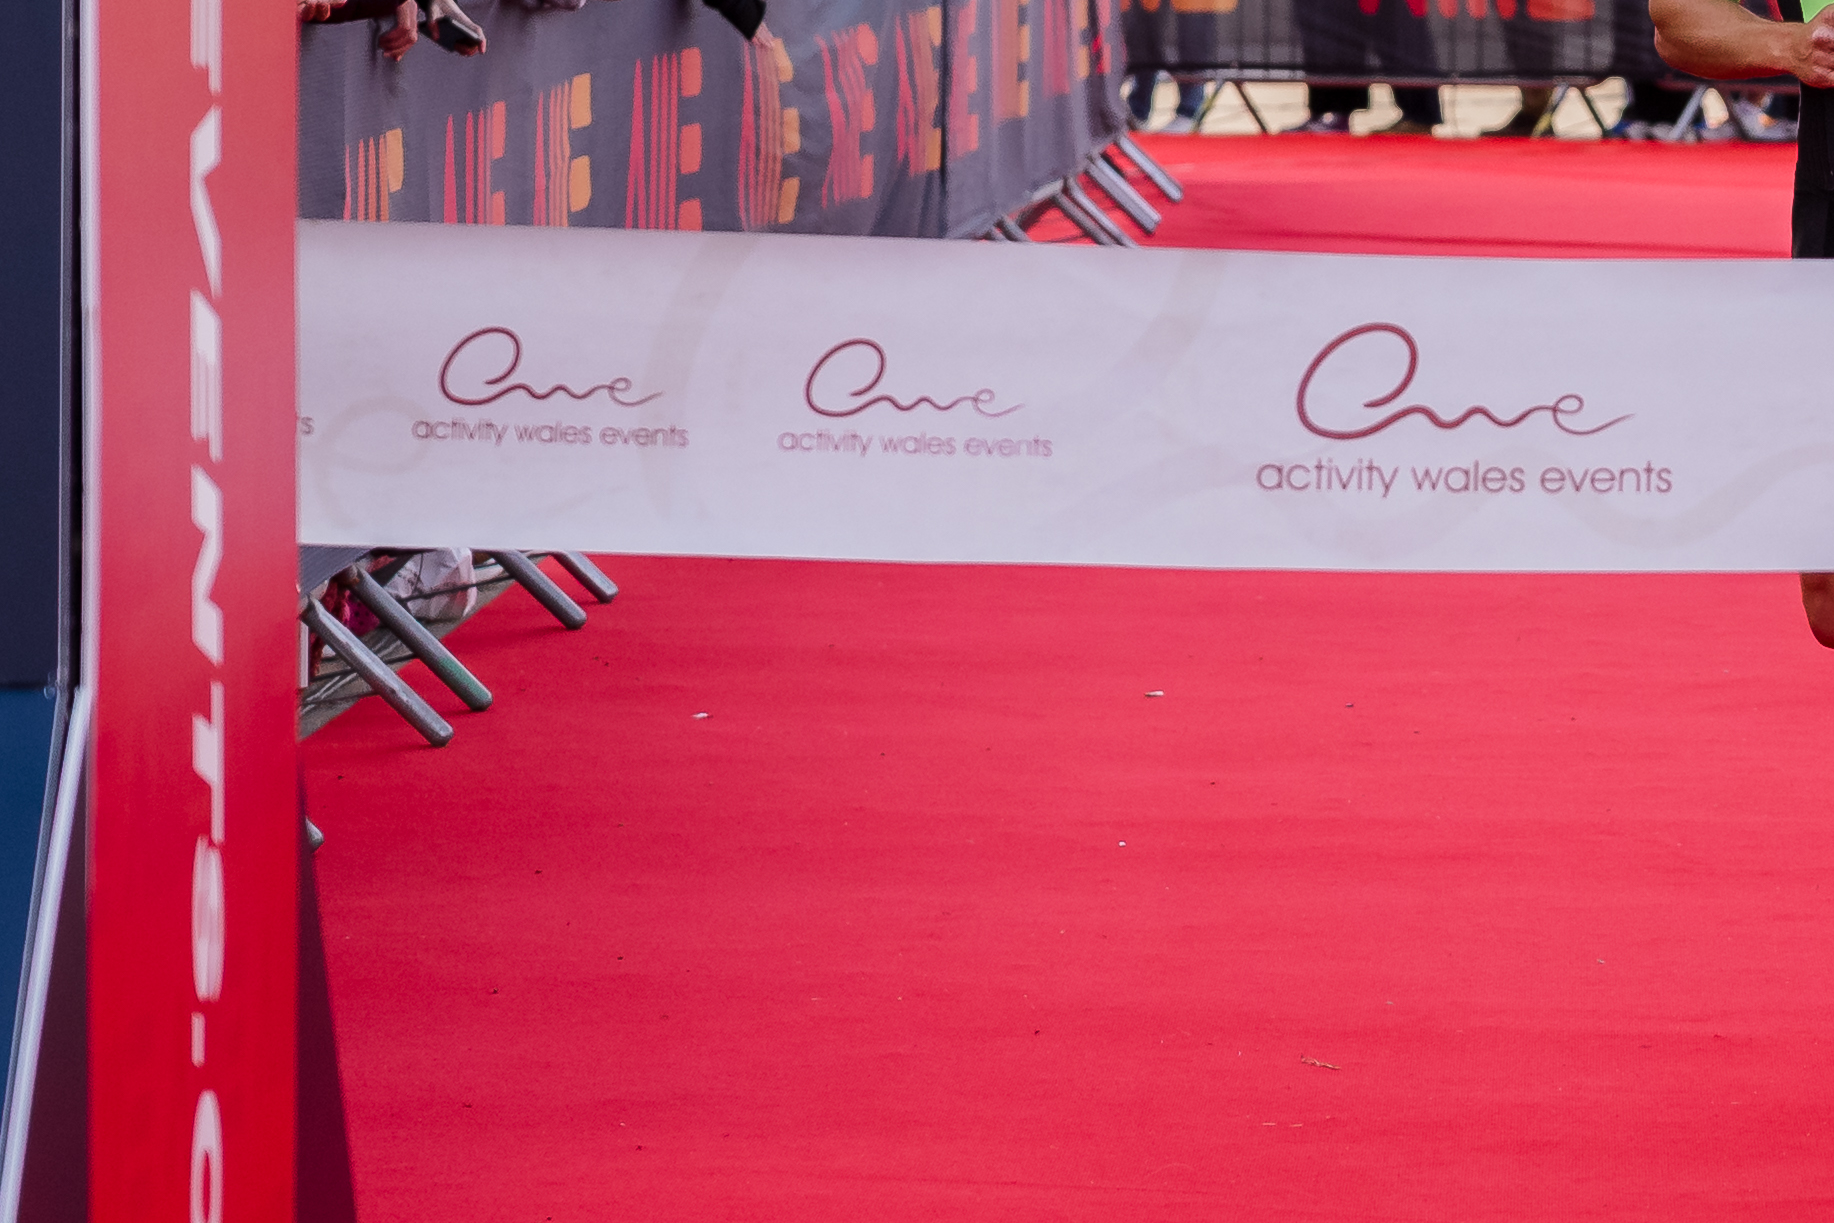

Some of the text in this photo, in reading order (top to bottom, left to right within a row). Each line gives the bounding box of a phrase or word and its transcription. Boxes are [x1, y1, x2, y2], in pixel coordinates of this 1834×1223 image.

[412, 415, 690, 450] activity wales events
[777, 428, 1054, 461] activity wales events
[1255, 458, 1674, 499] activity wales events
